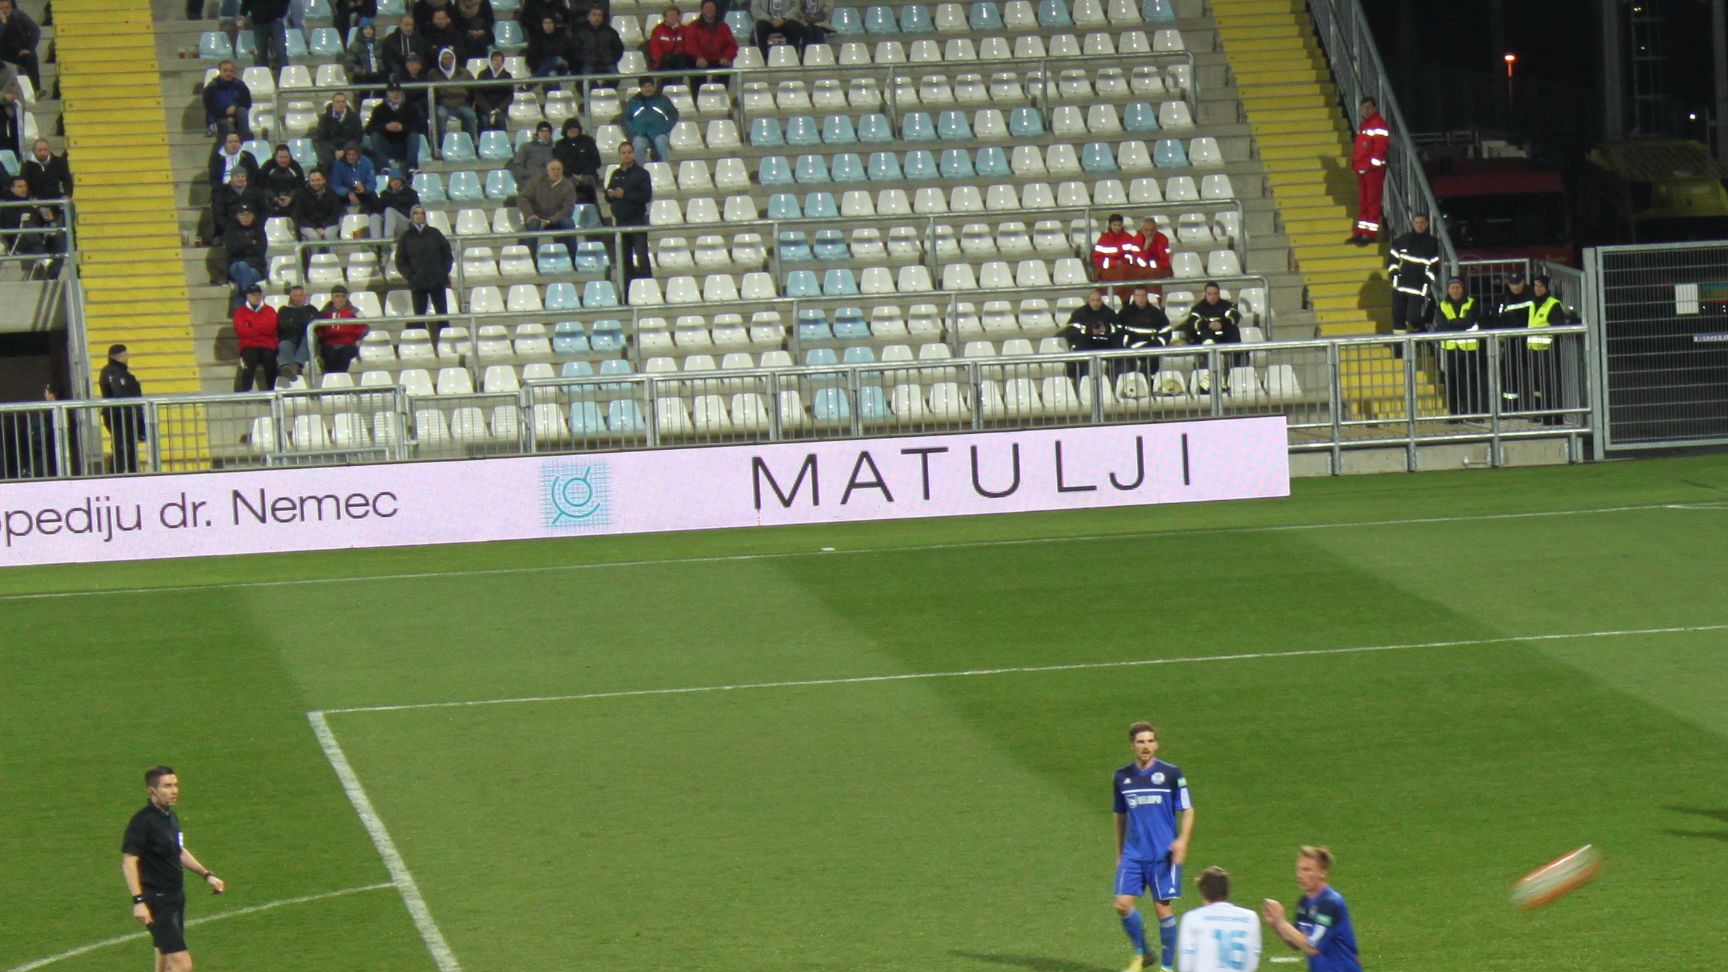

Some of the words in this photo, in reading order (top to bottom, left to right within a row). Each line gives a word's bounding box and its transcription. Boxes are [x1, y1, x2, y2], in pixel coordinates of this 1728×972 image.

[752, 433, 1190, 510] MATULJI
[0, 497, 142, 547] pediju
[160, 492, 212, 530] dr.
[232, 488, 399, 526] Nemec
